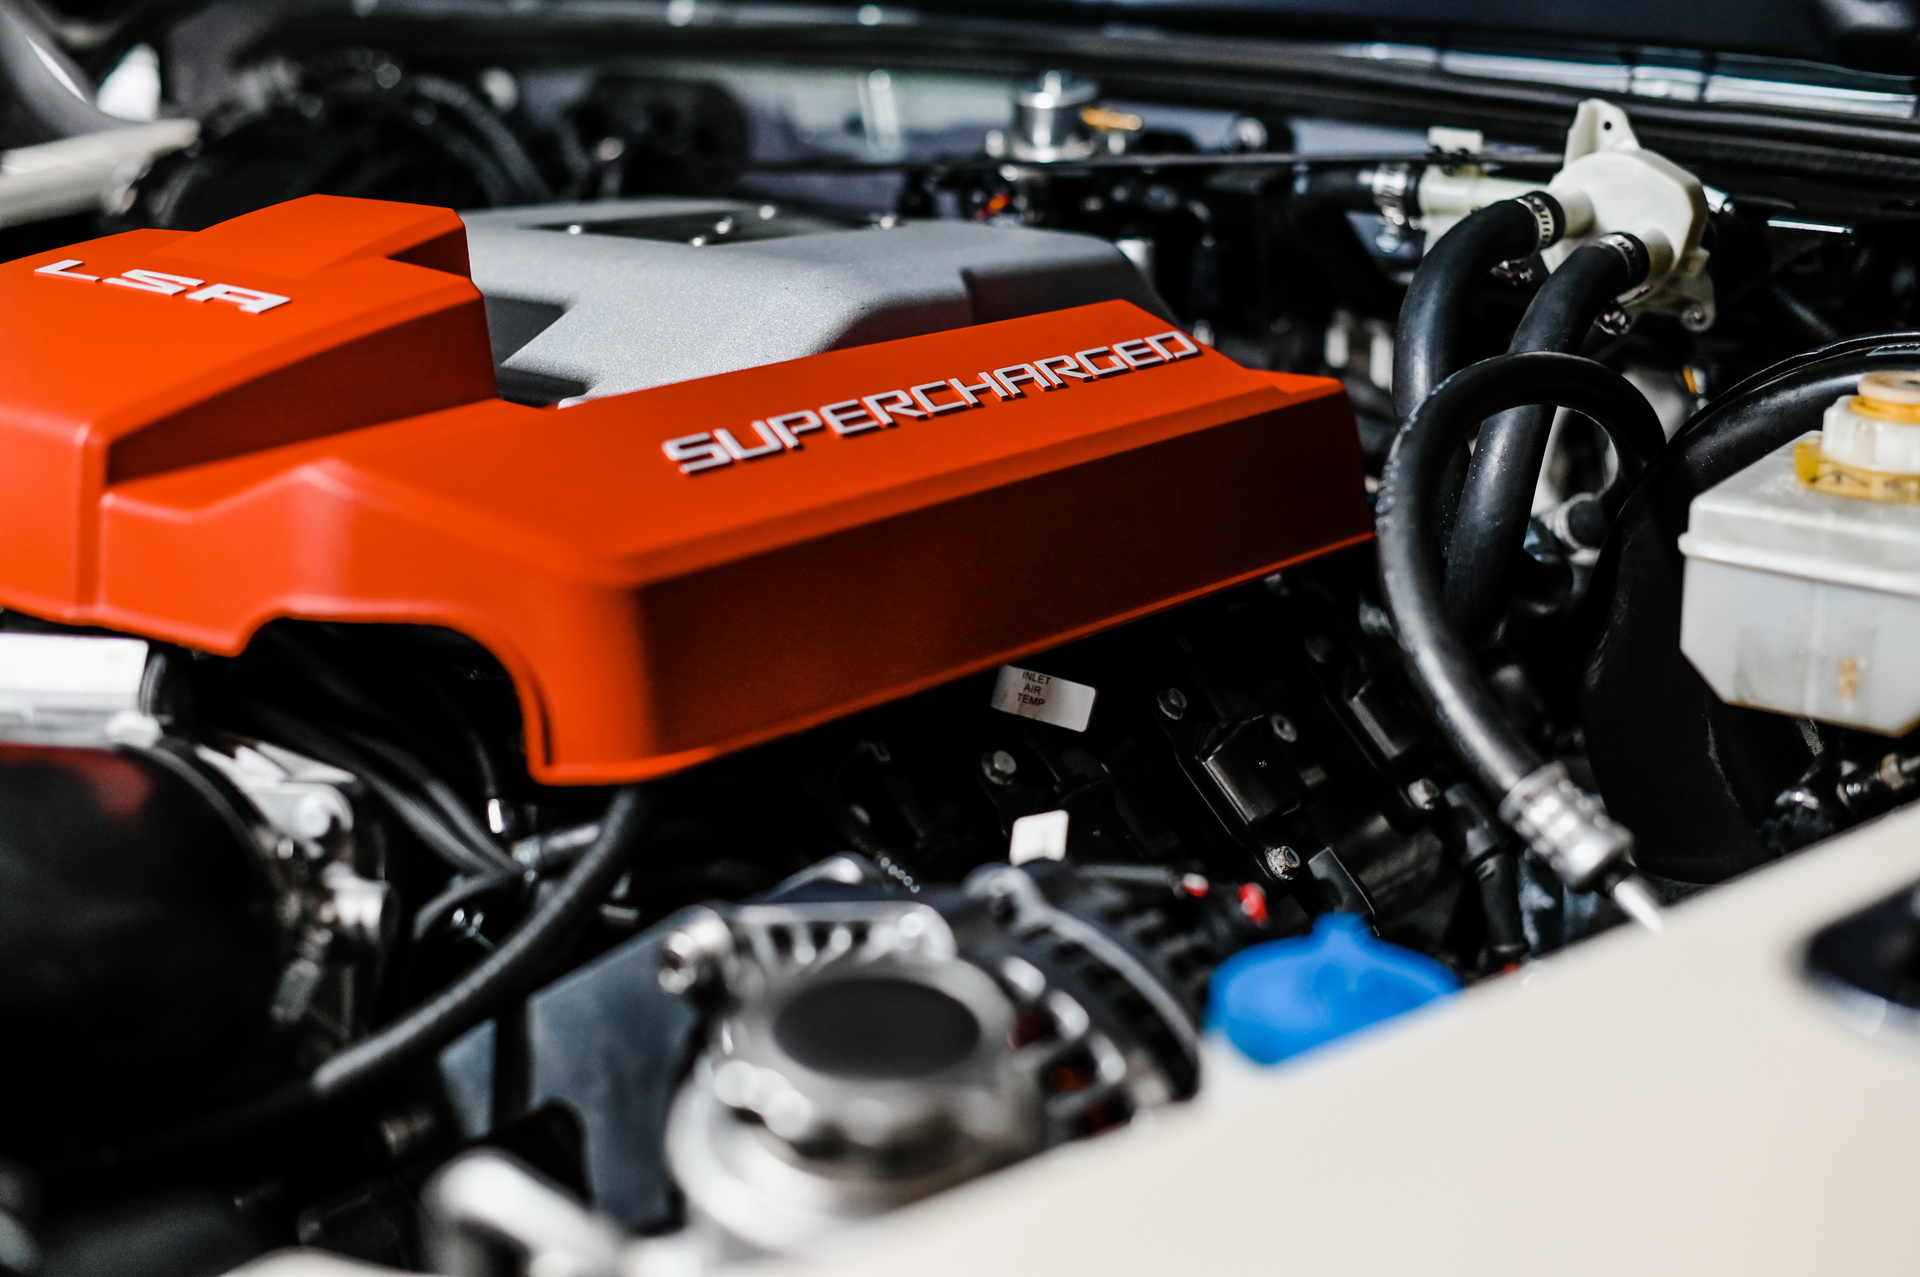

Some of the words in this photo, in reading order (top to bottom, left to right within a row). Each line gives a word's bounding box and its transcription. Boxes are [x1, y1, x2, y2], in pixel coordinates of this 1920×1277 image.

[34, 259, 291, 314] LSA
[662, 330, 1200, 473] SUPERCHARGED
[1022, 671, 1052, 685] INLET
[1023, 683, 1042, 695] AIR
[1017, 693, 1045, 707] TEMP
